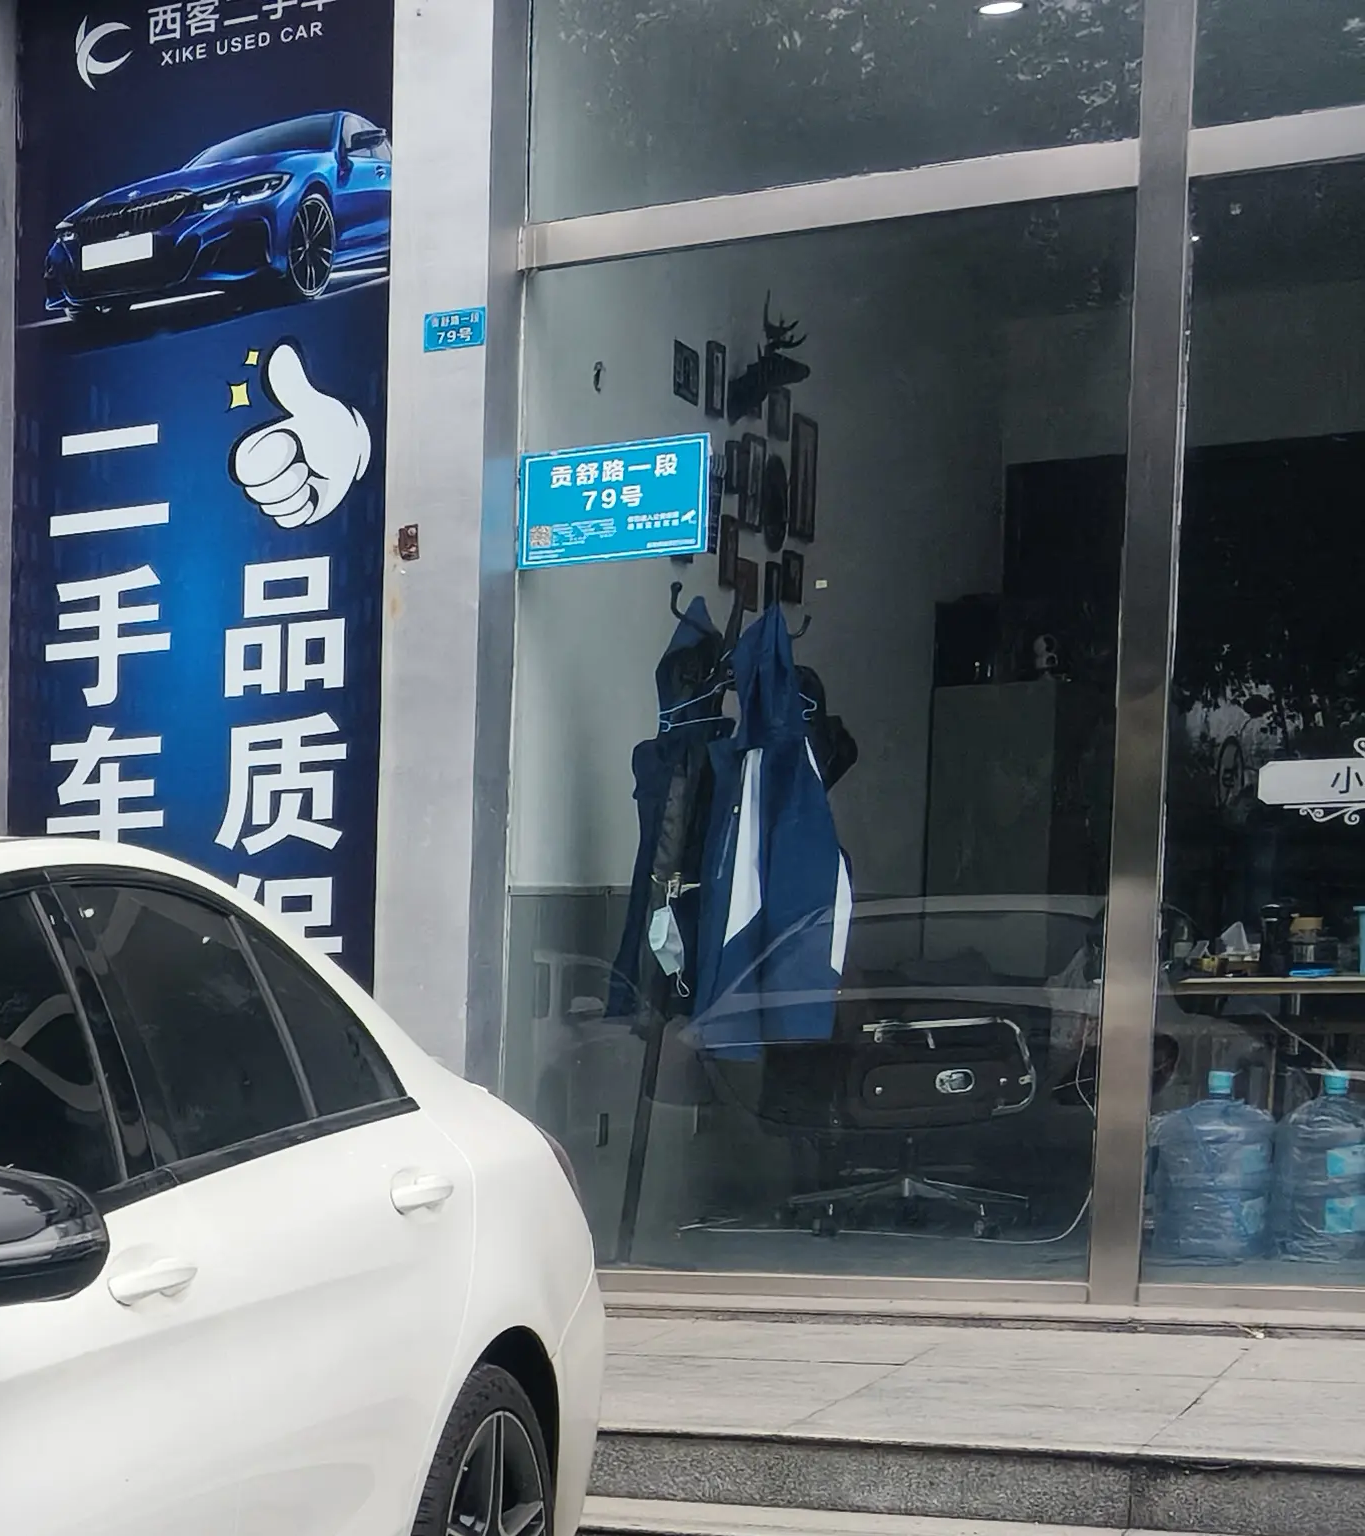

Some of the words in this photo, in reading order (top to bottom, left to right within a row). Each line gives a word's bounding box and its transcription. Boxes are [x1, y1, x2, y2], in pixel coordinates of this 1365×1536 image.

[148, 0, 335, 45] 西客二
[160, 43, 207, 66] XIKE
[216, 32, 270, 55] USED
[280, 22, 323, 43] CAR
[437, 327, 473, 344] 79号
[550, 453, 677, 489] 贡舒路一段
[581, 485, 643, 511] 79号
[45, 424, 171, 843] 二手车
